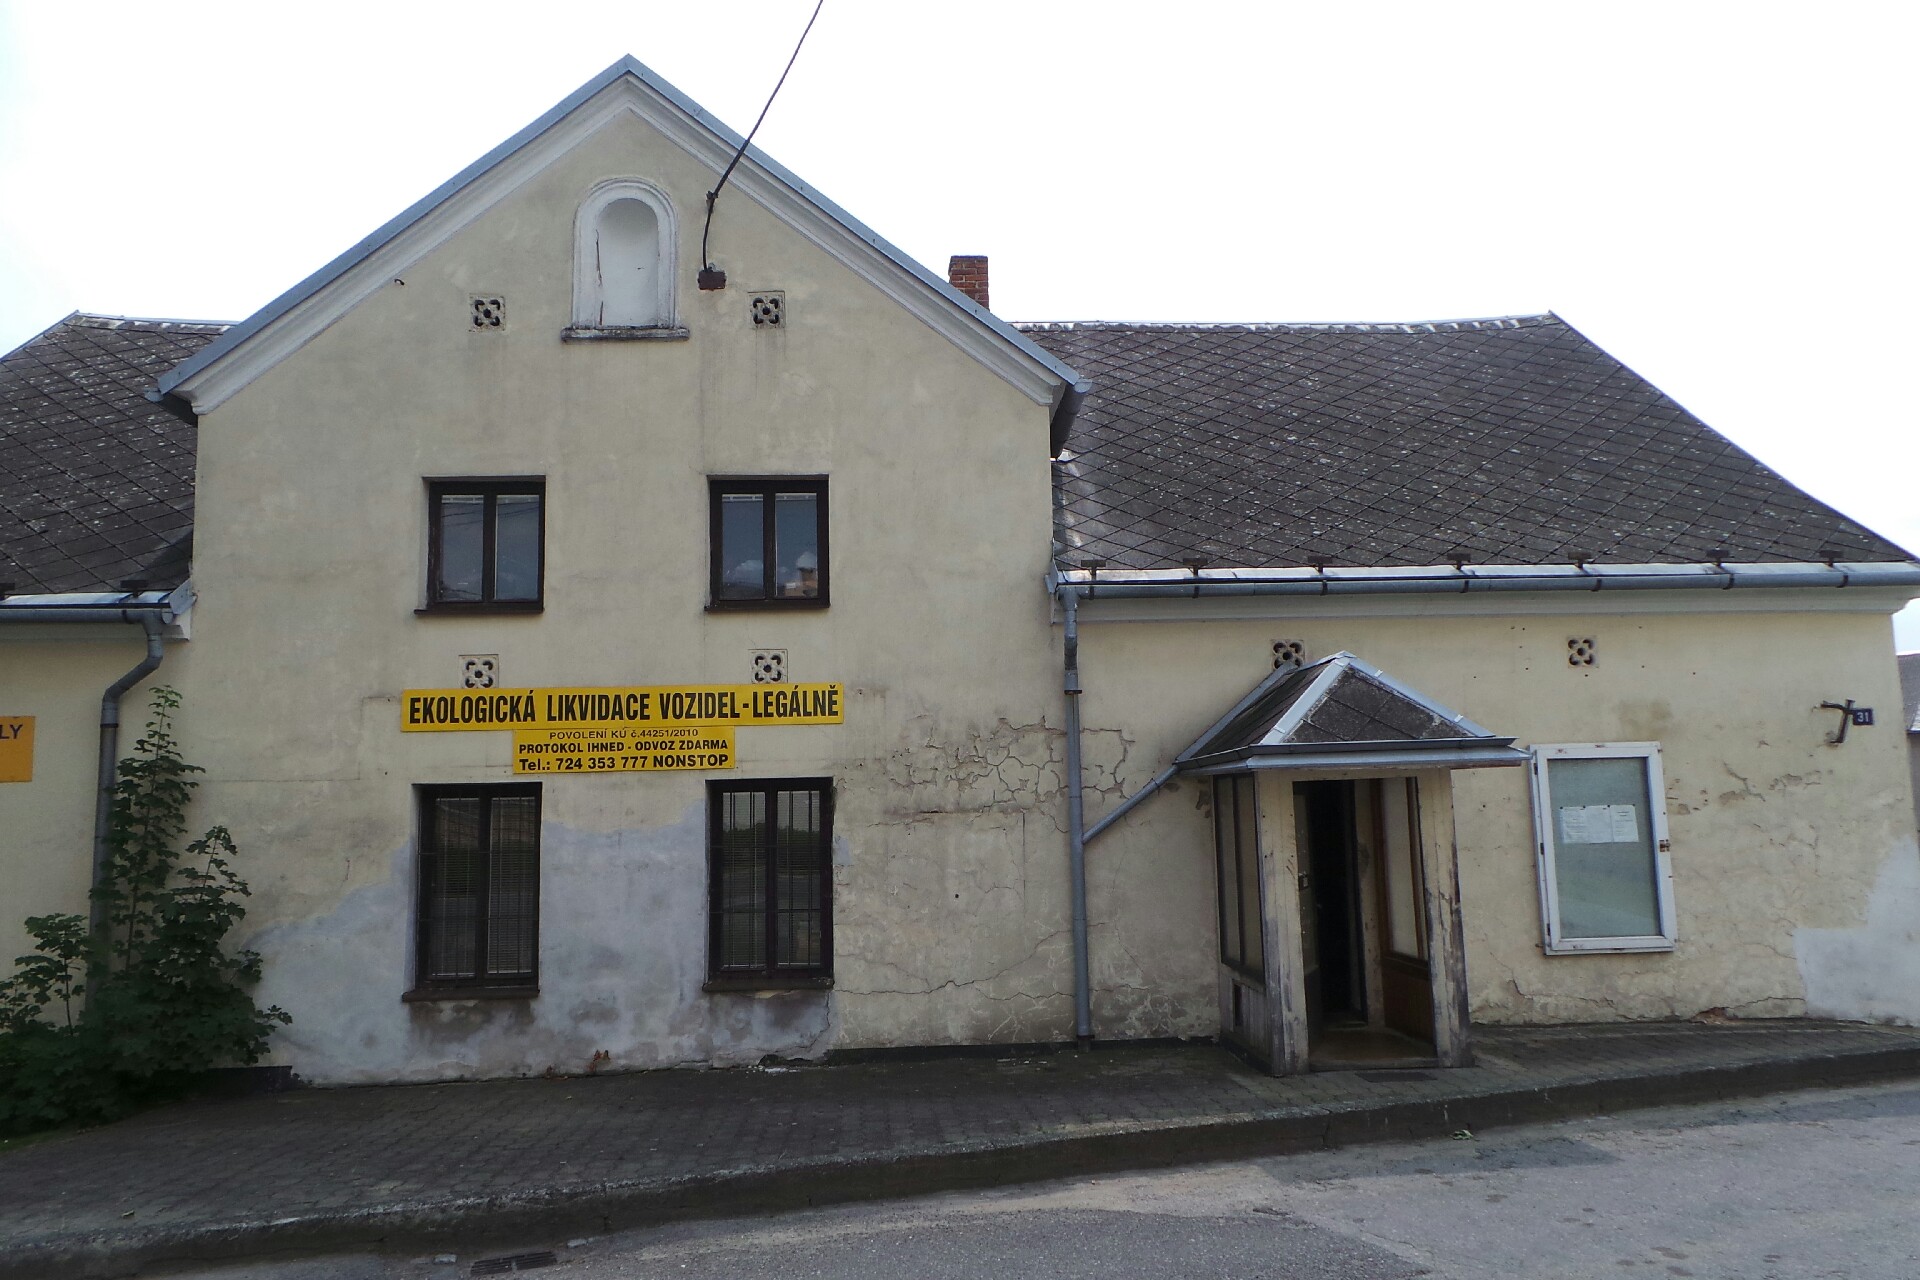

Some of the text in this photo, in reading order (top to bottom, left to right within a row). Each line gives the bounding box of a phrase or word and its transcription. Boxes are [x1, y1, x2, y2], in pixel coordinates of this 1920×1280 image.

[409, 689, 536, 724] EKOLOGICKÁ
[547, 692, 650, 722] LIKVIDACE
[1857, 711, 1869, 723] 31
[549, 728, 607, 740] POVOLENÍ
[519, 740, 583, 754] PROTOKOL
[587, 739, 625, 753] IHNED
[635, 739, 676, 751] ODVOZ
[679, 738, 729, 751] ZDARMA
[519, 754, 729, 771] Tel.: 724 353 777 NONSTOP
